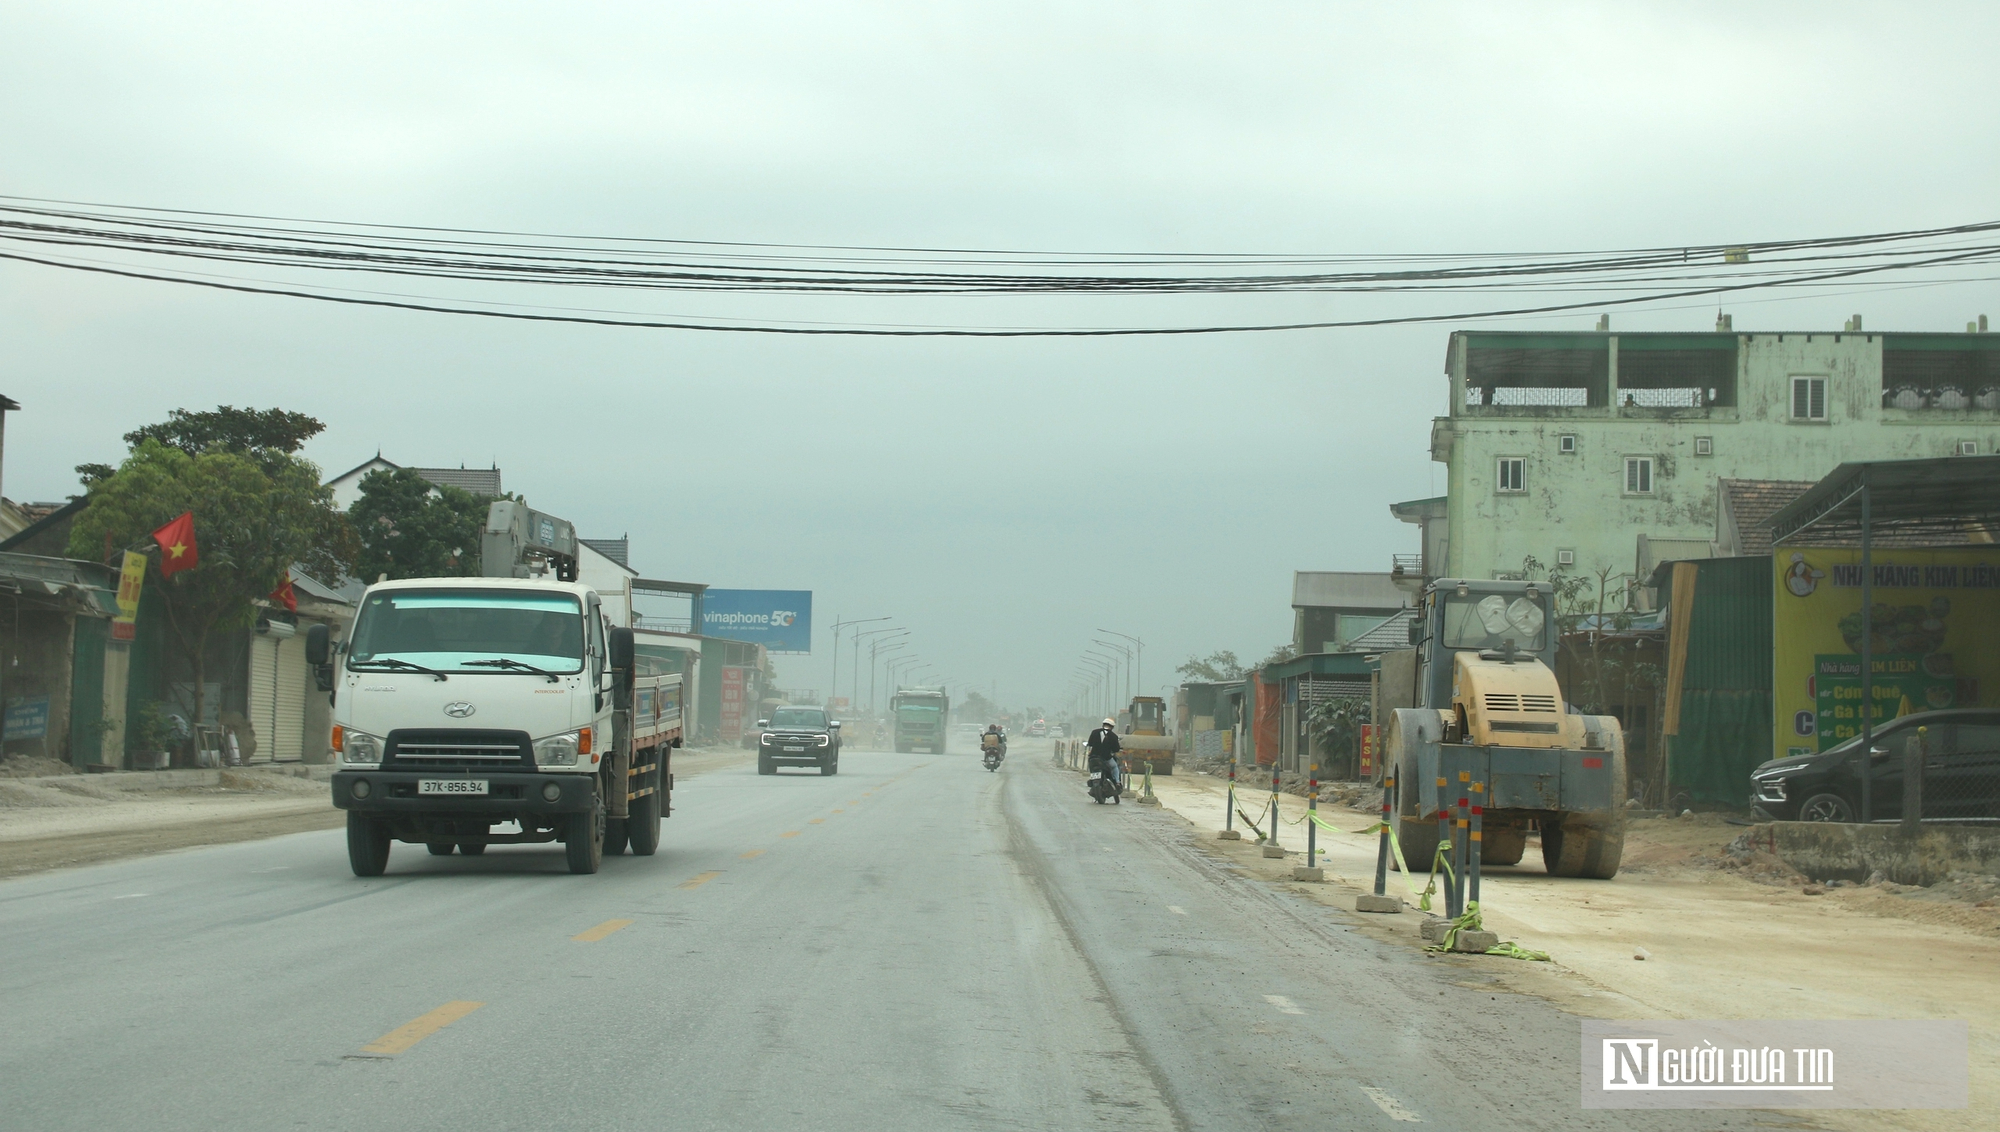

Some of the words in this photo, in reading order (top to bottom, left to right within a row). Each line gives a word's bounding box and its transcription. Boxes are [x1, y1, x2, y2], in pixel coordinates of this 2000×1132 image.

[1873, 560, 1919, 587] HÀNG
[1923, 565, 1958, 587] KIM
[1962, 561, 2000, 587] LIÊN
[703, 610, 769, 625] vinaphone
[1820, 661, 1838, 673] Nhà
[1839, 661, 1860, 675] hàng
[1868, 661, 1885, 673] IM
[1889, 658, 1916, 673] LIÊN
[1871, 684, 1901, 700] Quê
[1834, 704, 1854, 719] Gà
